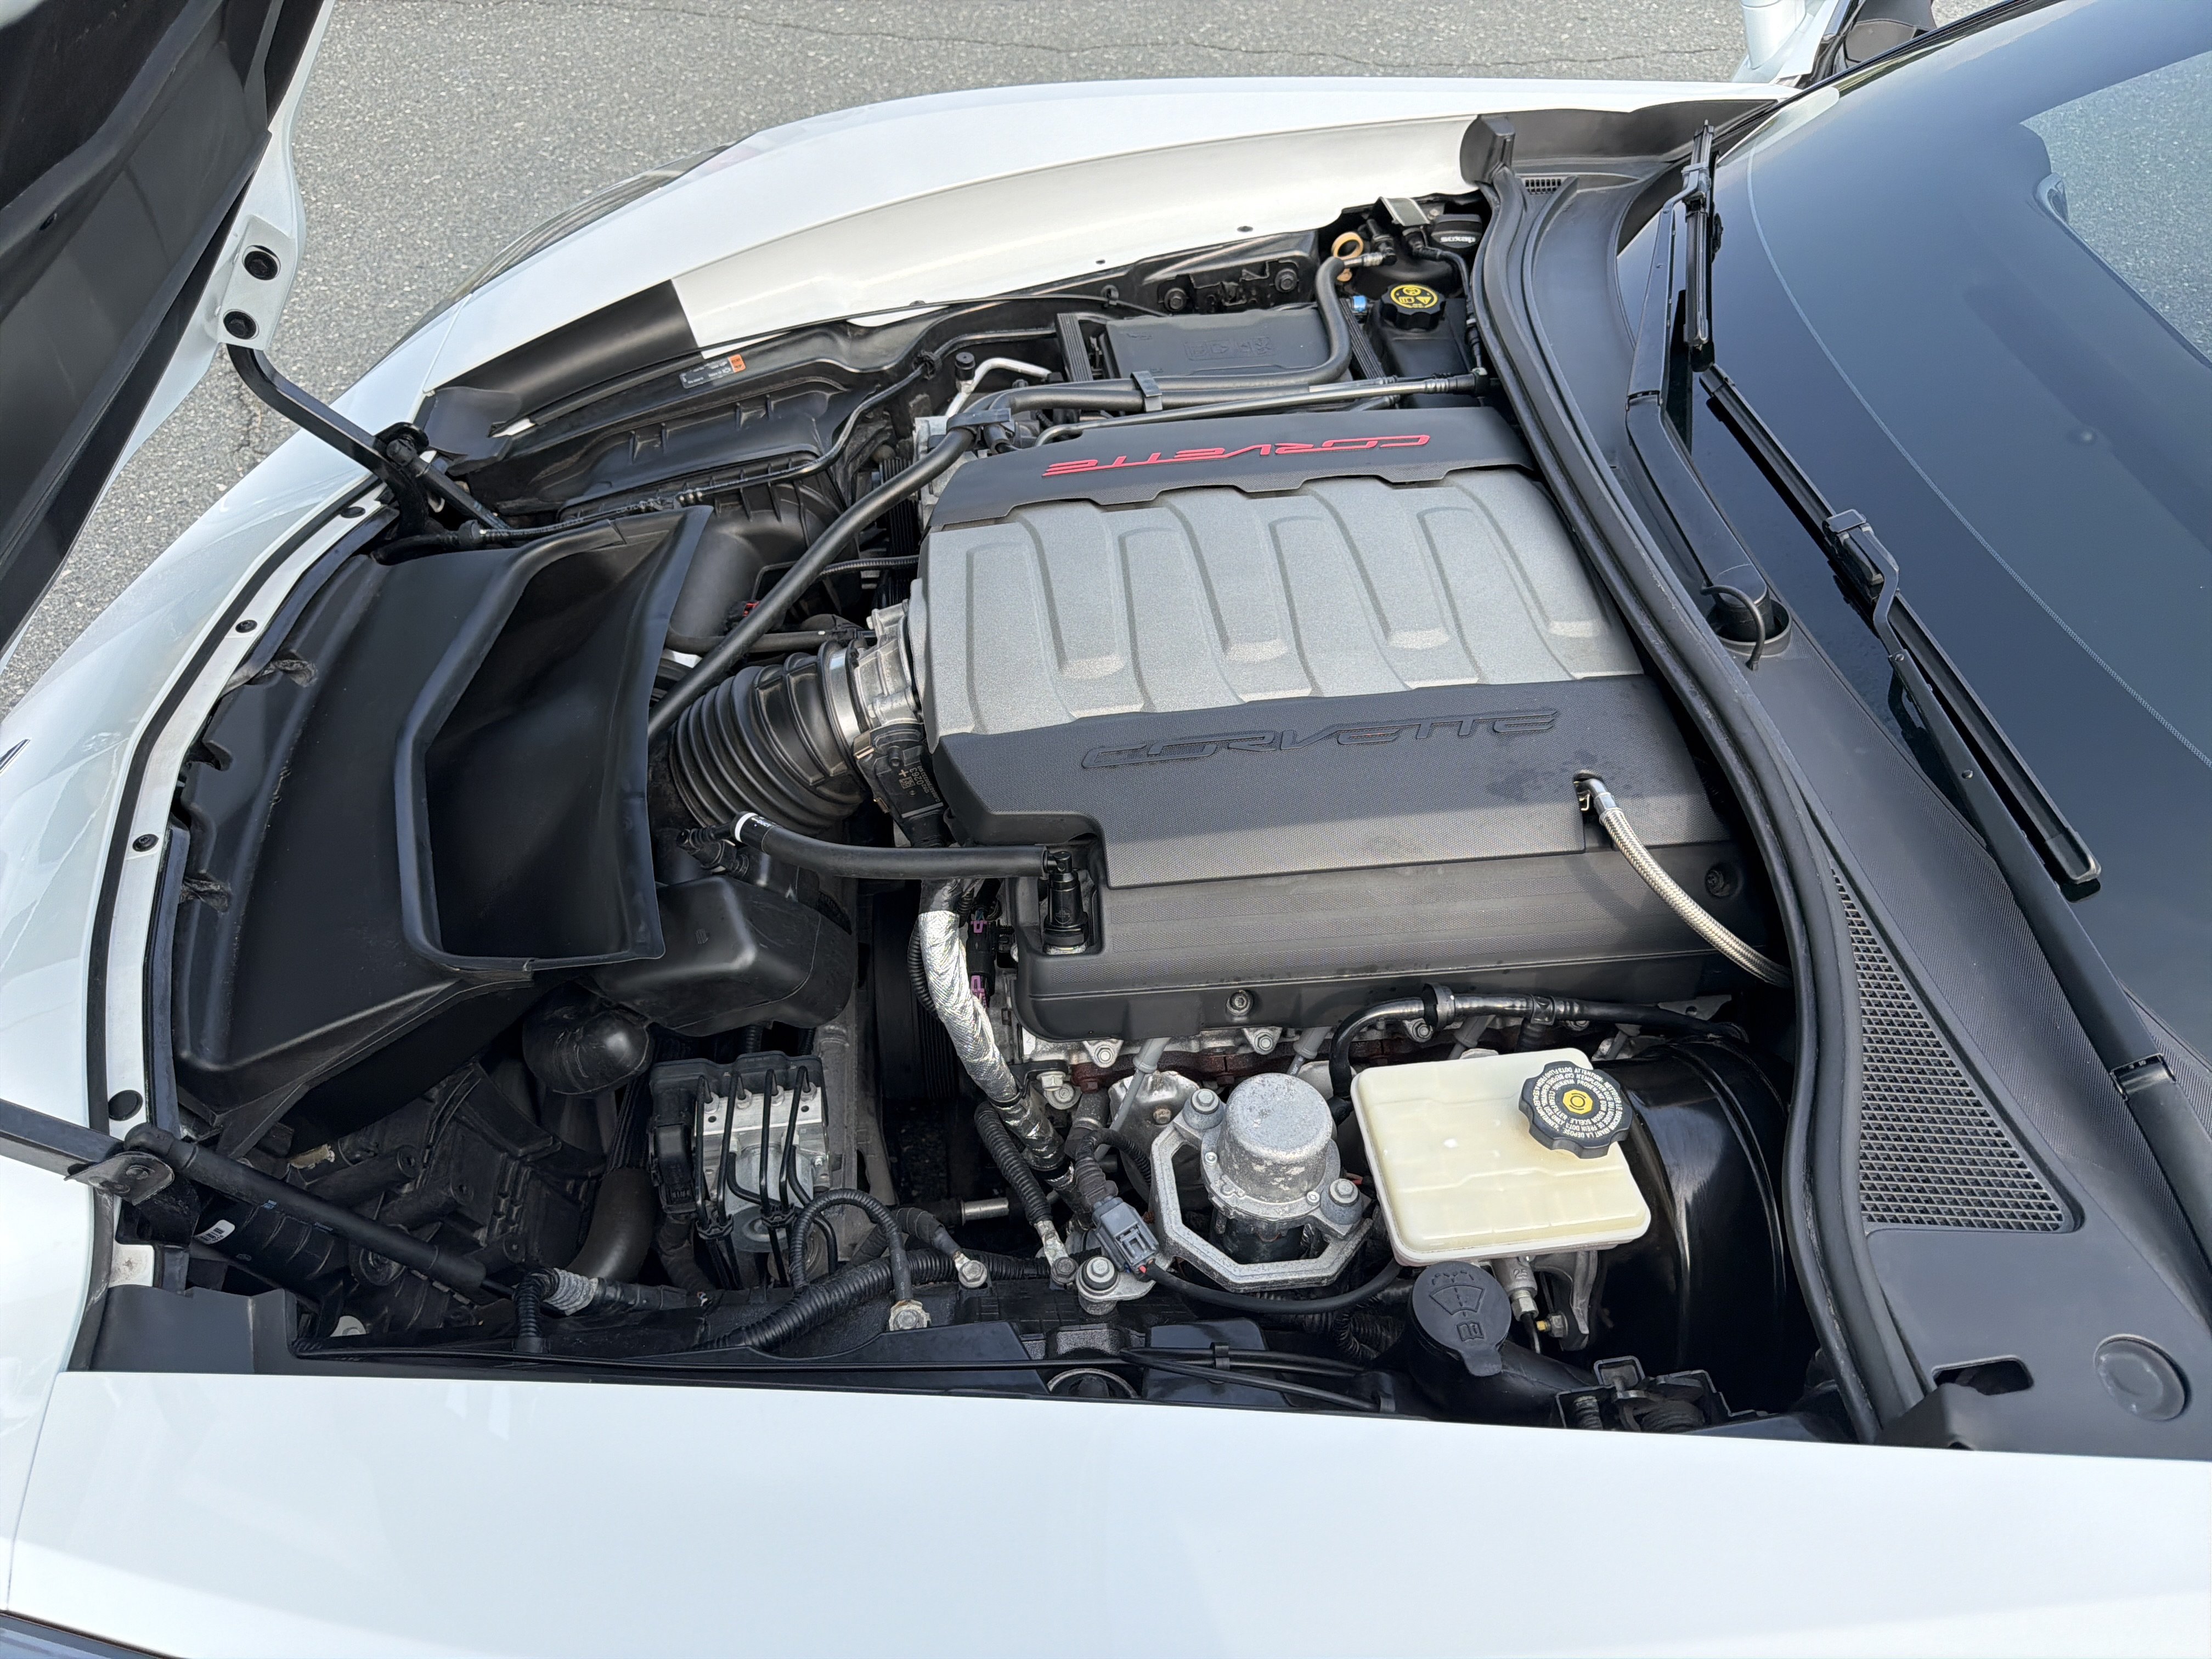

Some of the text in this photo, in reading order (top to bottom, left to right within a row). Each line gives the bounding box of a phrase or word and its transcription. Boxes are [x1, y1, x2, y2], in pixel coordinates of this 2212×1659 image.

[1042, 435, 1430, 477] CORVETTE
[1081, 709, 1559, 769] CORVETTE
[1544, 1068, 1560, 1079] FLUID
[1546, 1074, 1566, 1087] BEFORE
[1536, 1075, 1549, 1087] FROM
[1577, 1080, 1606, 1099] PROVENANT
[1603, 1081, 1622, 1103] NETTOYER
[1603, 1091, 1613, 1101] QUE
[1533, 1089, 1541, 1107] SEALED
[1548, 1090, 1556, 1105] CLEAN
[1544, 1106, 1555, 1116] USE
[1551, 1105, 1568, 1121] FILLER
[1591, 1110, 1605, 1124] BIDON
[1601, 1108, 1615, 1125] LIQUIDE
[1551, 1114, 1566, 1126] ONLY
[1565, 1122, 1580, 1132] DOT3
[1607, 1110, 1623, 1131] BOUCHON
[1594, 1127, 1611, 1138] AVANT
[1513, 1268, 1528, 1279] 25
